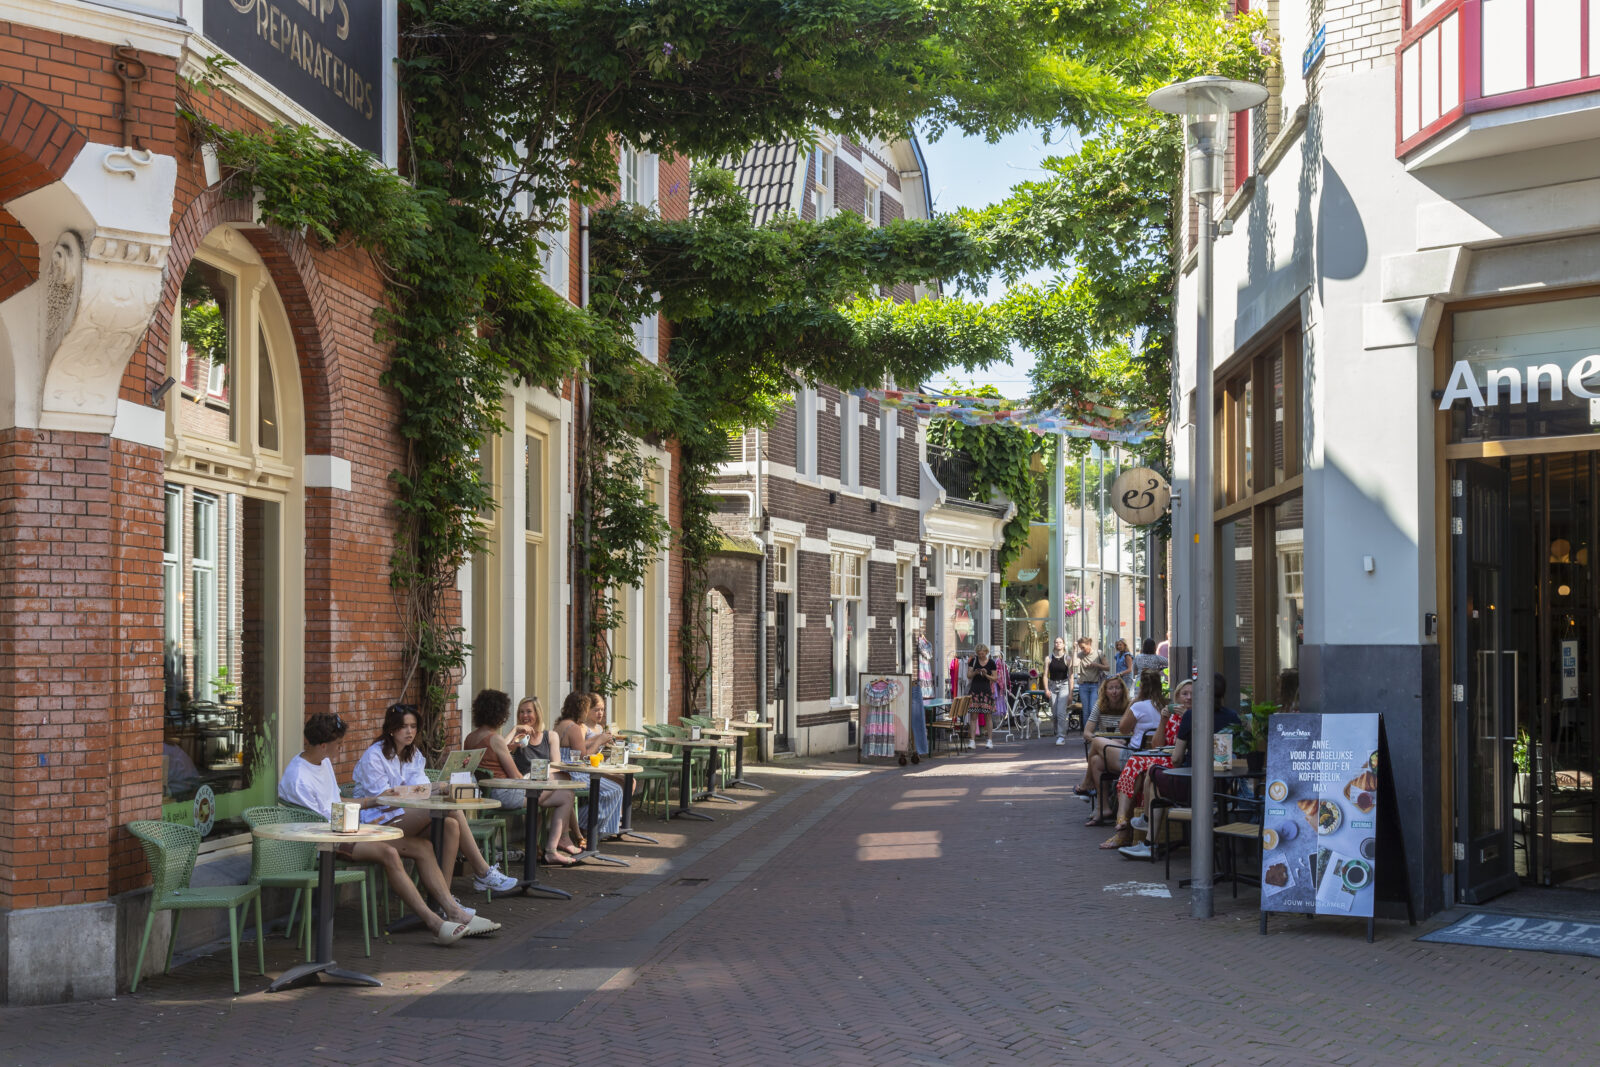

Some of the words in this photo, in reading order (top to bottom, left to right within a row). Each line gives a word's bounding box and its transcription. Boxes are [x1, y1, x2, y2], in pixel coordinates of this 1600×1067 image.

[256, 0, 373, 121] REPARATEURS
[1290, 751, 1307, 760] VOOR
[1307, 751, 1315, 760] JE
[1316, 751, 1354, 760] DAGELIJKSE
[1292, 762, 1311, 771] DOSIS
[1341, 762, 1350, 771] EN
[1445, 927, 1476, 936] JE
